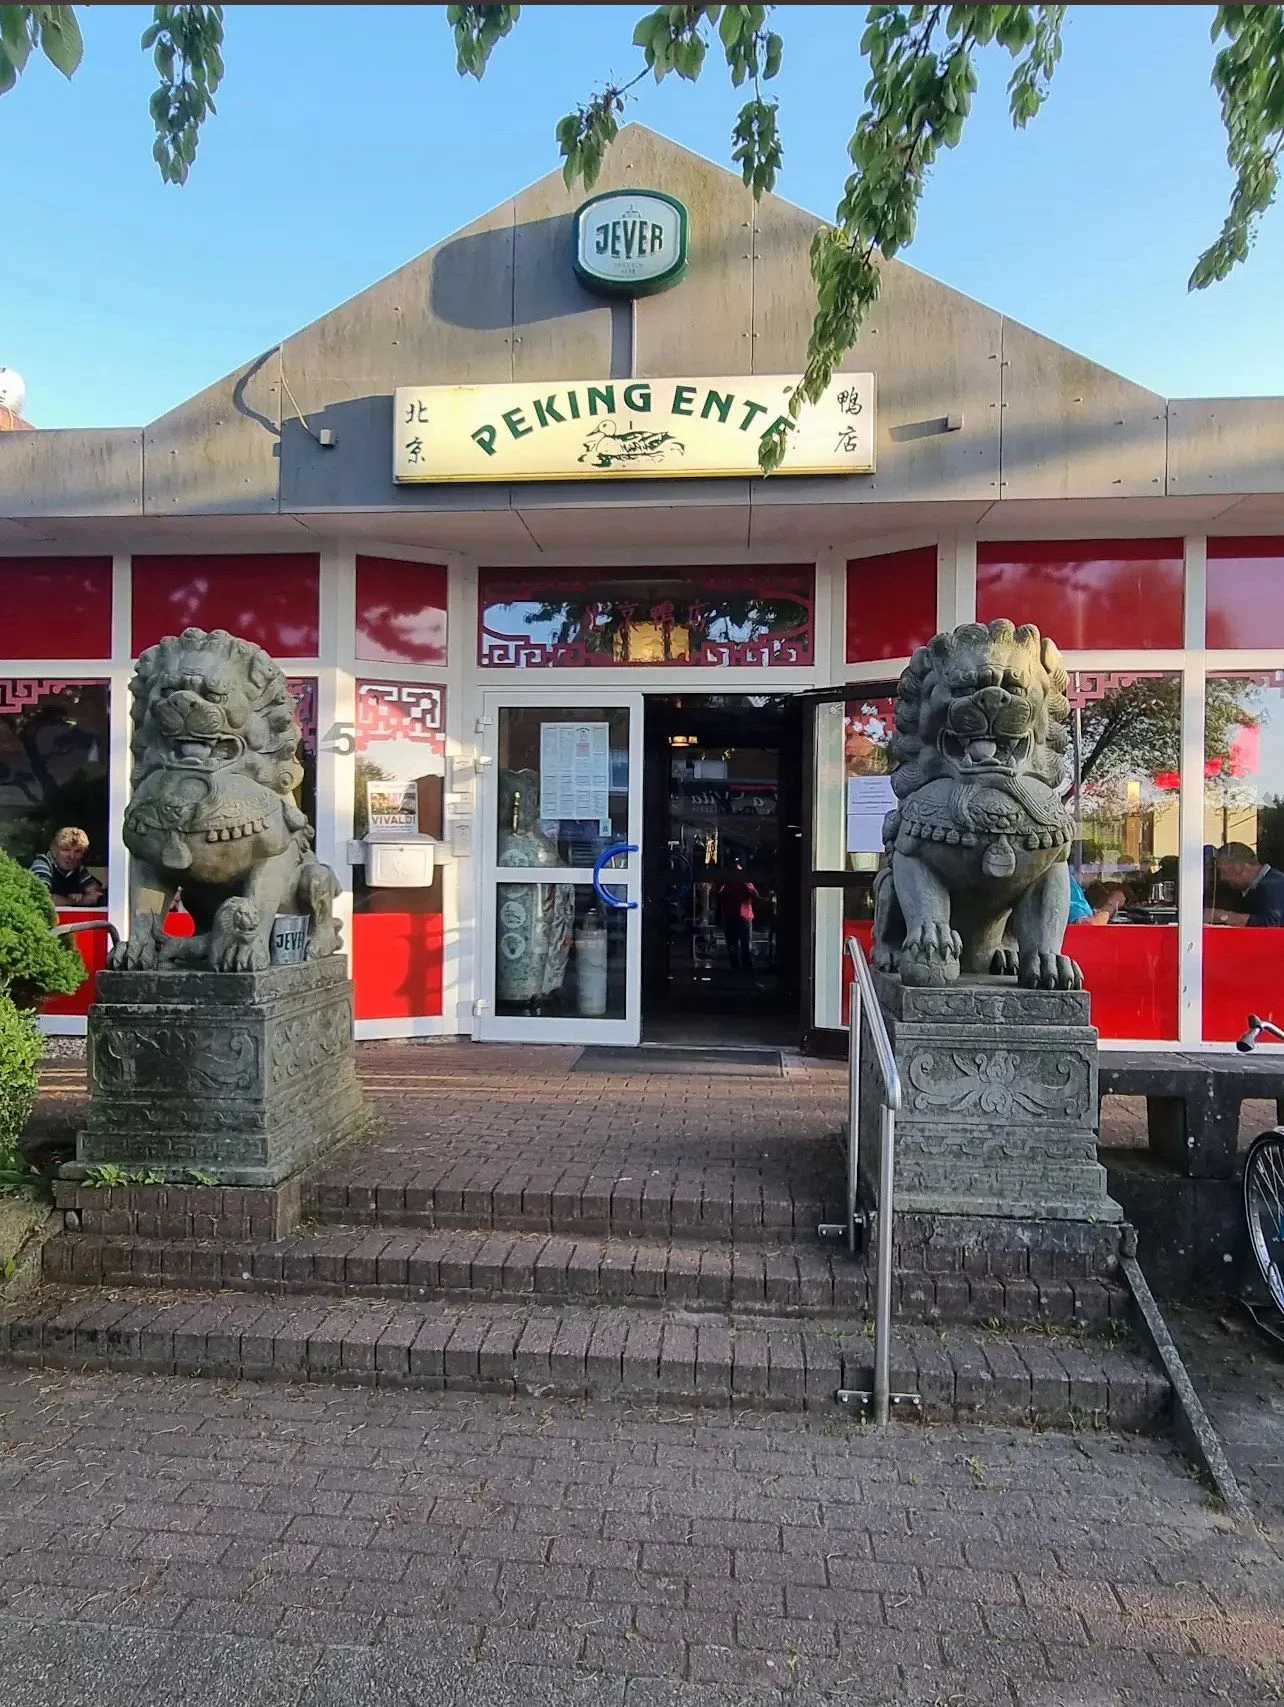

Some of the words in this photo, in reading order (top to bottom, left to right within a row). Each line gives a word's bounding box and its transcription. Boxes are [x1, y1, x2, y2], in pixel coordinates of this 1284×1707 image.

[595, 219, 663, 259] JEVER
[405, 399, 429, 464] 北京
[470, 383, 651, 456] PEKING
[321, 722, 355, 756] 5
[372, 815, 416, 825] VIVALDI
